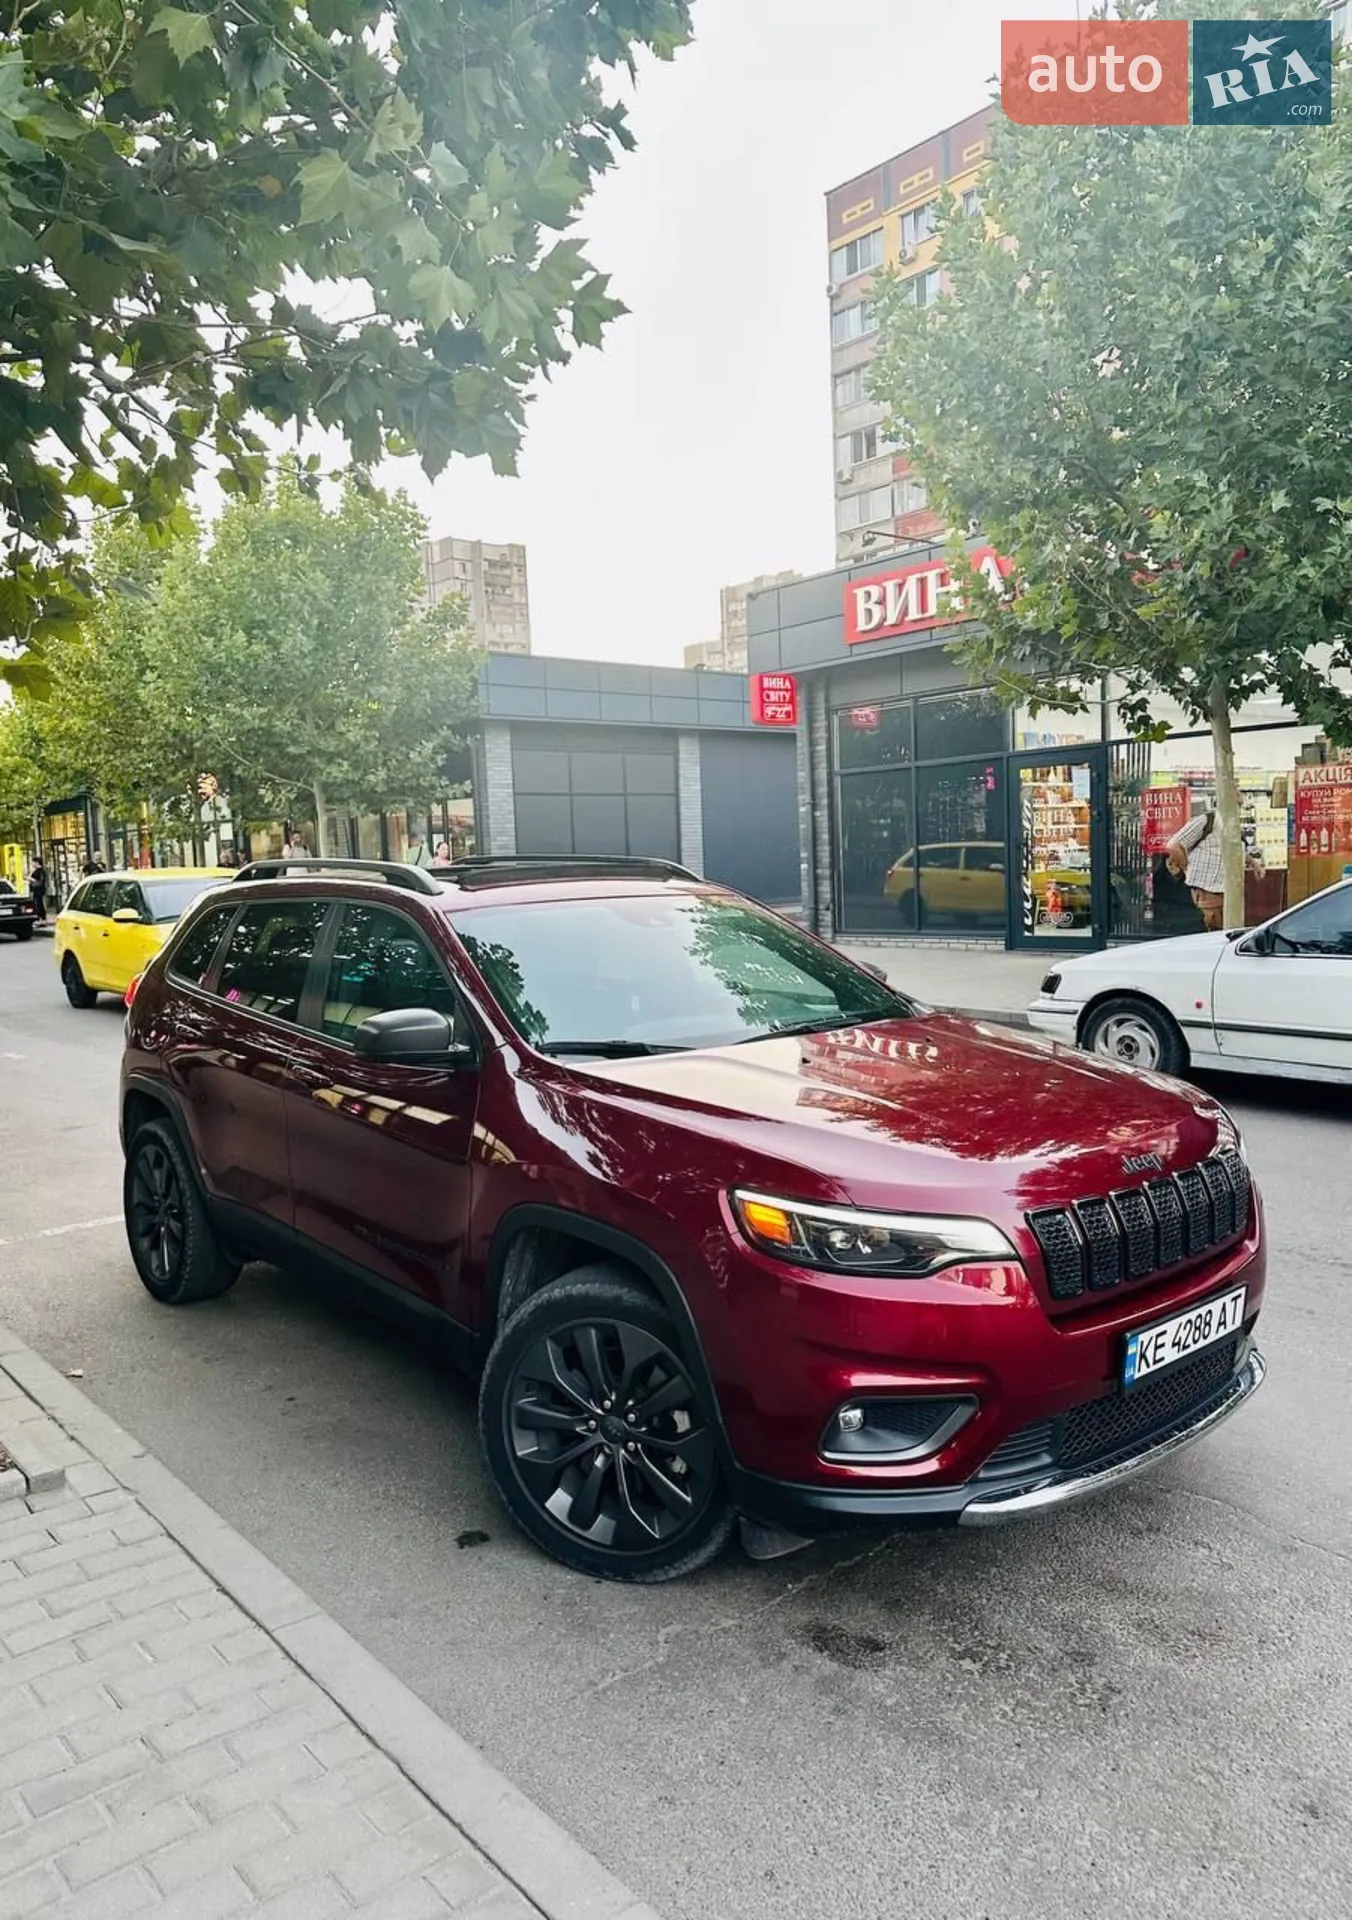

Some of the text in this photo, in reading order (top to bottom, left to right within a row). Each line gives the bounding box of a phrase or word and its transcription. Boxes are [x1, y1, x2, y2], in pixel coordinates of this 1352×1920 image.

[763, 677, 792, 689] ВИНА
[1301, 767, 1352, 784] АКЦІЯ
[1145, 791, 1183, 805] ВИНА
[1145, 806, 1182, 820] СВІТУ
[1120, 1152, 1162, 1175] Jeep
[1138, 1293, 1243, 1373] KE 4288 AT
